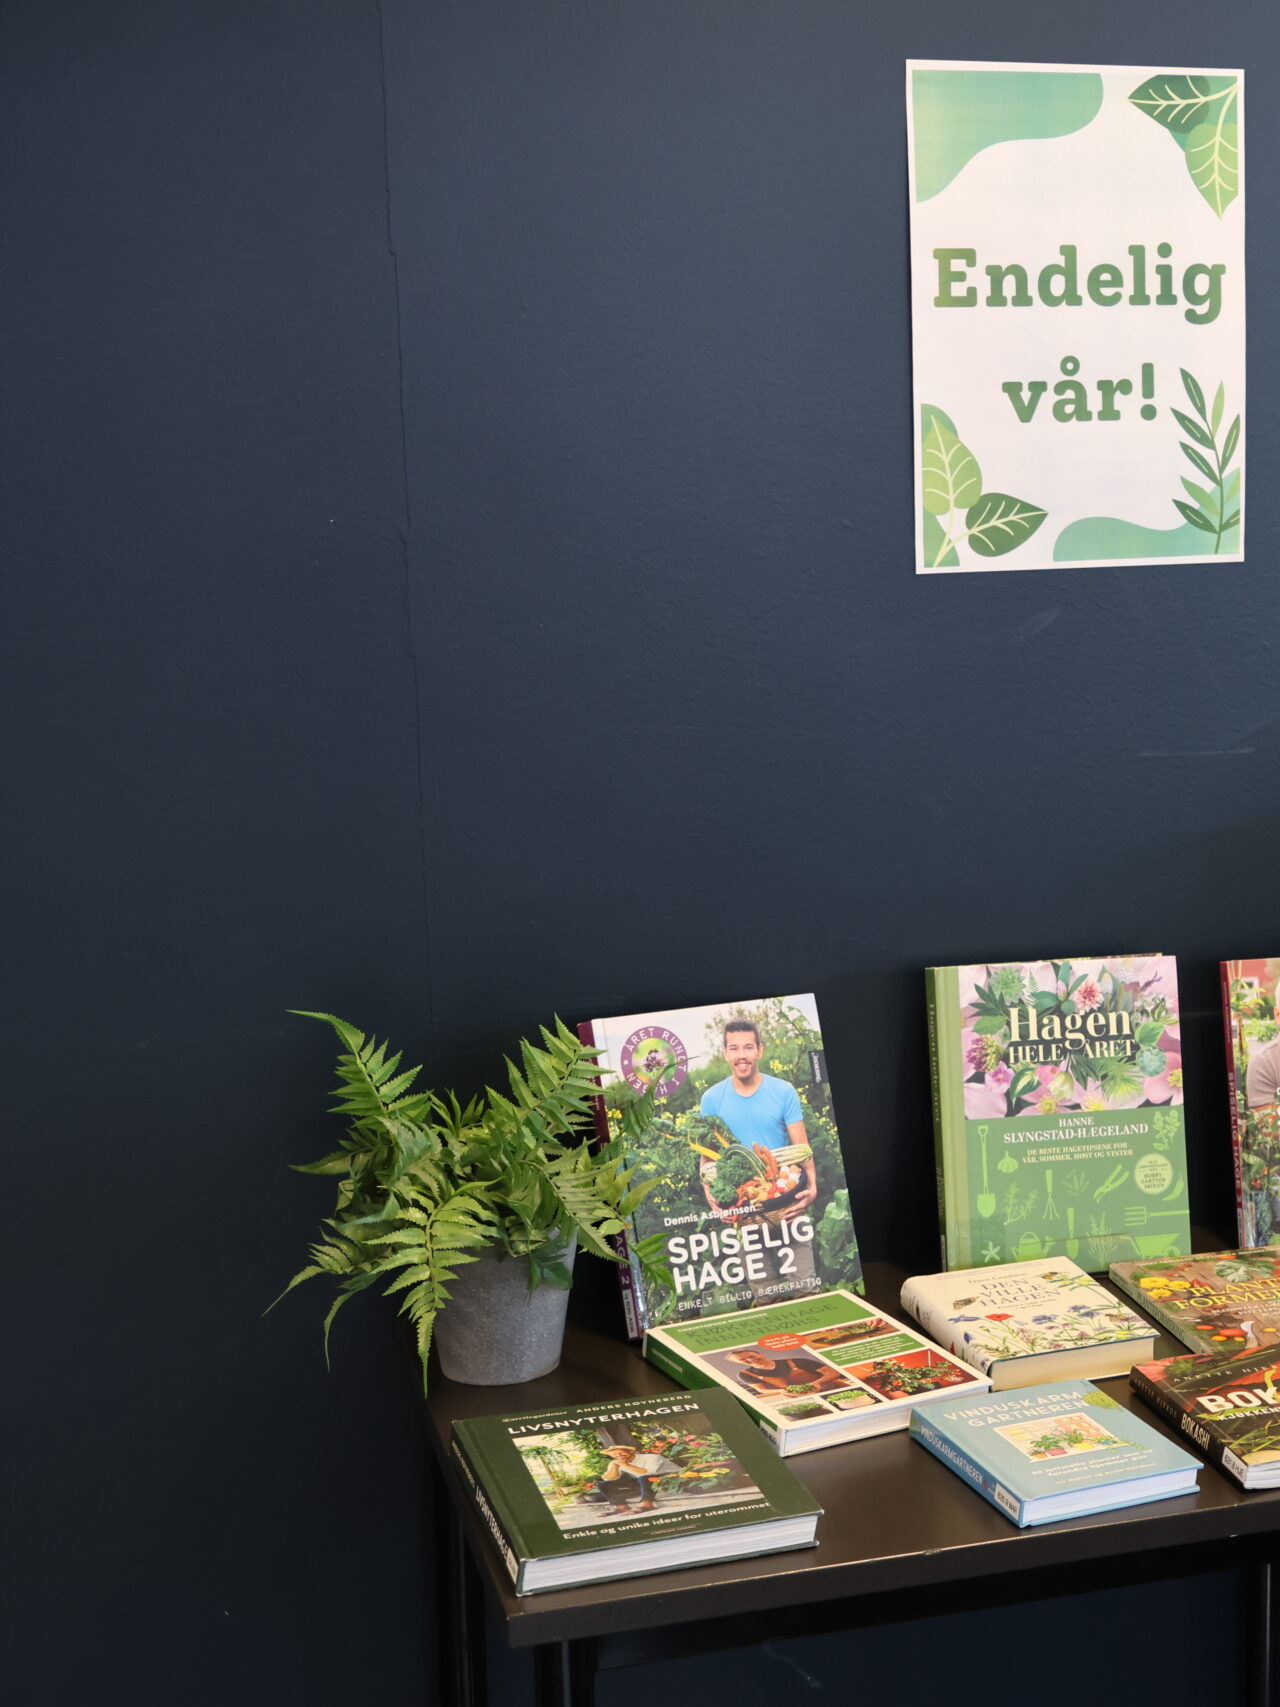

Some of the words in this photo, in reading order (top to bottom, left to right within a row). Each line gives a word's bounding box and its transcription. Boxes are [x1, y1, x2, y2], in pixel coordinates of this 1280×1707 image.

[933, 242, 1226, 324] Endelig
[1001, 355, 1158, 423] vår!
[1009, 1006, 1133, 1050] Hagen
[623, 1027, 655, 1053] ÅRET
[661, 1030, 687, 1072] RUNDT
[1009, 1043, 1065, 1065] HELE
[1083, 1036, 1136, 1059] ÅRET
[1058, 1116, 1094, 1128] HANNE
[1228, 1071, 1238, 1143] SPISELIG
[1003, 1123, 1149, 1144] SLYNGSTAD-HÆGELAND
[1039, 1147, 1061, 1155] BESTE
[1113, 1142, 1128, 1150] FOR
[1094, 1151, 1105, 1159] OG
[1106, 1149, 1134, 1157] VINTER
[1232, 1144, 1242, 1190] HAGE
[664, 1213, 698, 1227] Dennis
[701, 1204, 756, 1221] Asbjørnsen
[614, 1235, 629, 1271] AGE
[669, 1215, 815, 1265] SPISELIG
[673, 1253, 769, 1293] HAGE
[779, 1248, 798, 1274] 2
[978, 1277, 1031, 1290] DEN
[678, 1296, 714, 1312] ENKELT
[719, 1290, 752, 1305] BILLIG
[758, 1277, 822, 1296] BÆREKRAFTIG
[976, 1288, 1064, 1307] HAGEN
[977, 1283, 1048, 1299] VILLE
[683, 1302, 840, 1339] KJØKKENHAGE
[693, 1315, 823, 1346] INNENDØRS
[506, 1402, 702, 1435] LIVSNYTERHAGEN
[574, 1403, 623, 1413] ANDERS
[942, 1390, 1084, 1421] VINDUSKARM
[964, 1399, 1092, 1427] GARTNEREN
[1180, 1412, 1211, 1452] BOKASHI
[920, 1424, 984, 1486] VINDUSKARMGARTNEREN
[562, 1528, 599, 1541] Enkle
[598, 1526, 617, 1536] og
[615, 1520, 652, 1532] unike
[650, 1514, 683, 1526] ideer
[682, 1511, 704, 1520] for
[703, 1501, 772, 1517] uterommet
